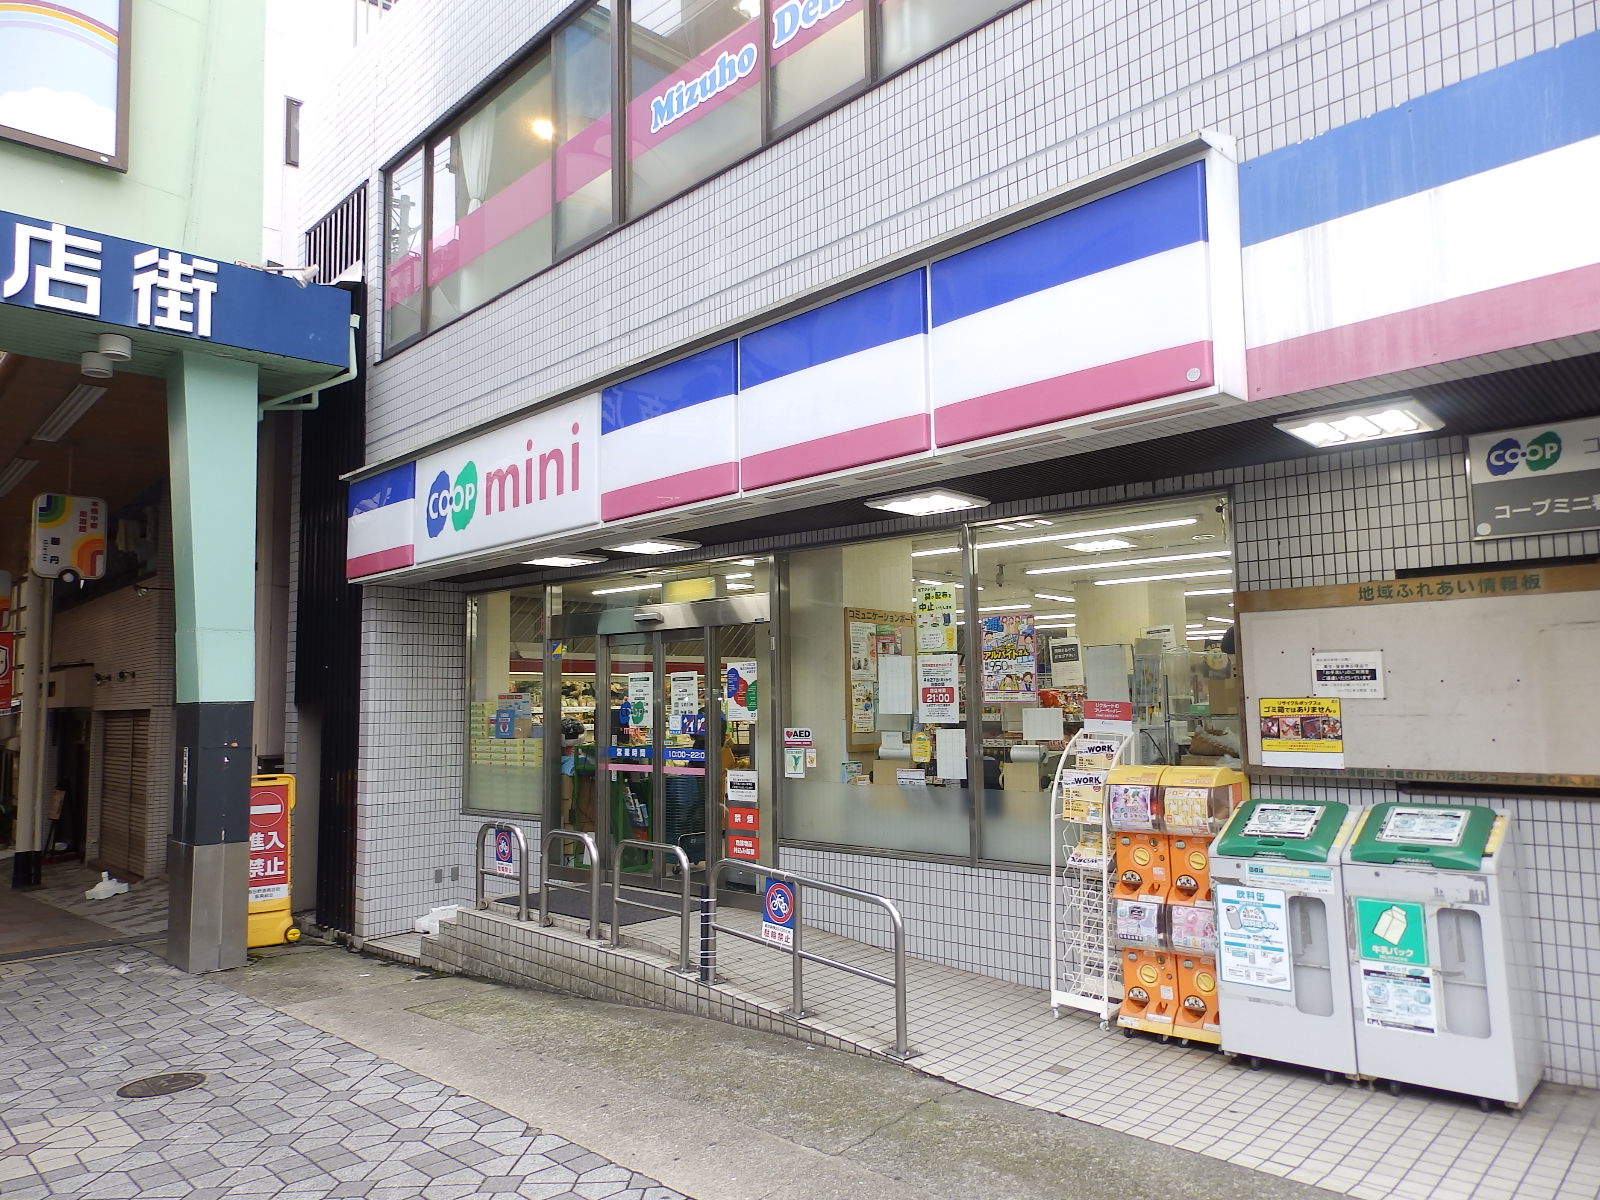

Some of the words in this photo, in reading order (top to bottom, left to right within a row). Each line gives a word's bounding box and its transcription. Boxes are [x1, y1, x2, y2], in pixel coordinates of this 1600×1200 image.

[651, 43, 757, 133] Mizuho
[3, 222, 218, 338] 店街
[485, 422, 580, 517] mini
[1358, 574, 1541, 602] 地域ふれあい情報板
[848, 609, 916, 625] コミュニケーションボード
[926, 693, 950, 703] 21:00
[1263, 706, 1337, 714] ゴミ箱ではありません。
[793, 730, 811, 738] AED
[617, 749, 646, 758] 営業時間
[1087, 744, 1115, 756] WORK
[1074, 776, 1102, 788] WORK
[249, 856, 285, 878] 禁止
[1236, 890, 1265, 901] 飲料缶
[764, 928, 791, 943] 駐輪禁止
[1371, 944, 1414, 957] 牛乳パック
